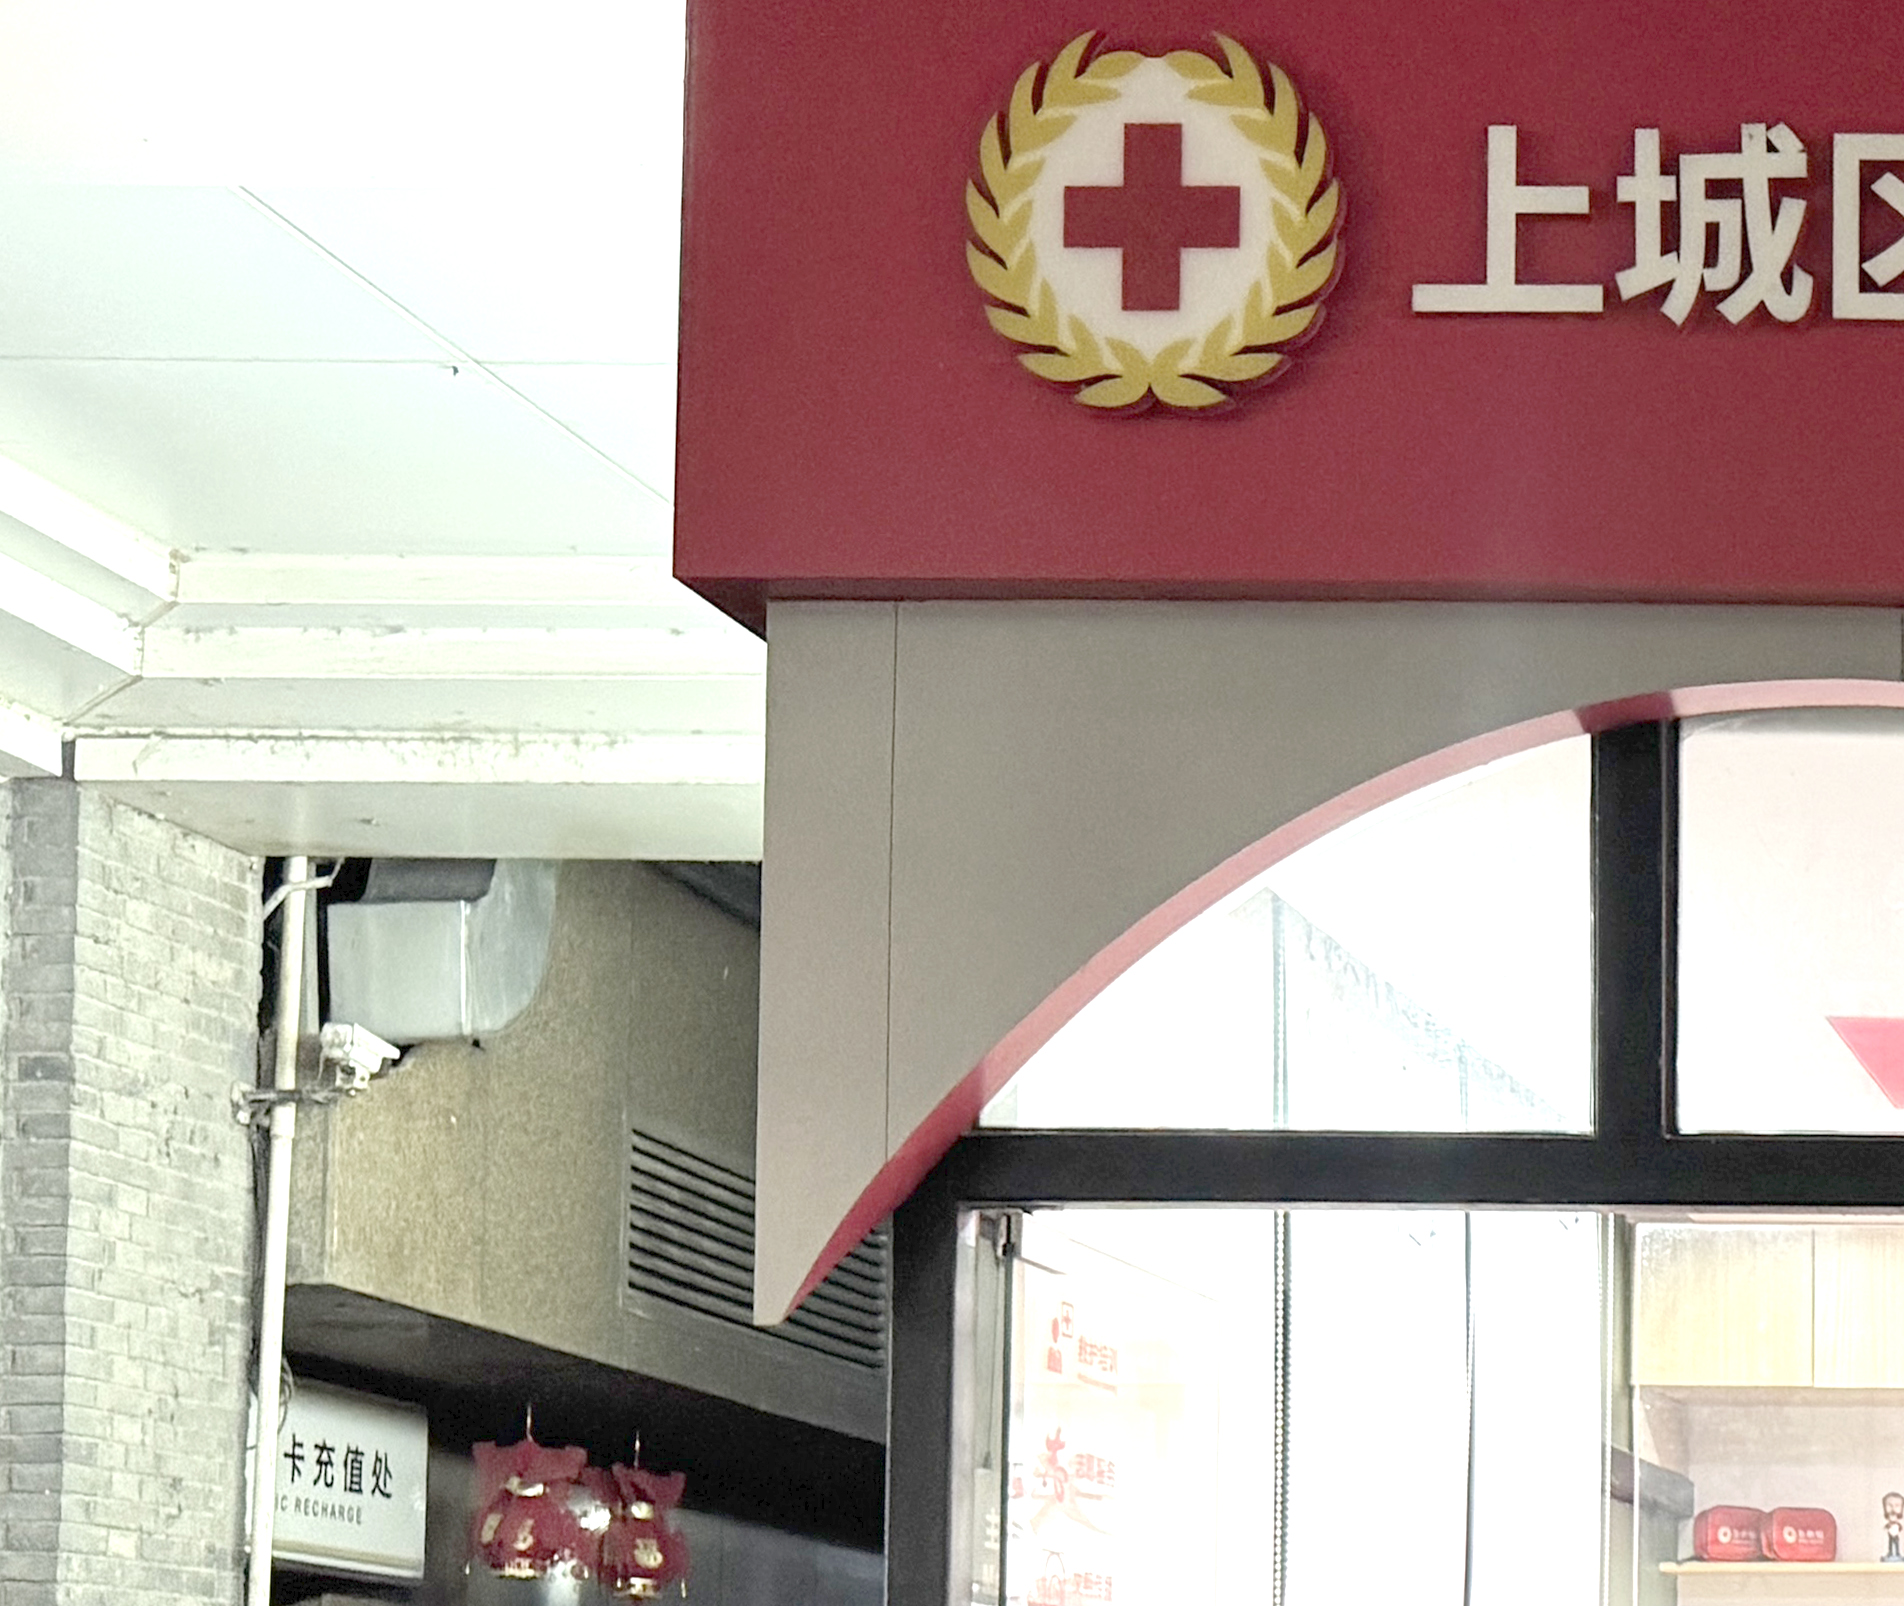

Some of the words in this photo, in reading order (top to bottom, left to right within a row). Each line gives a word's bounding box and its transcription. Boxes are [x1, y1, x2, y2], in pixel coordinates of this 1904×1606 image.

[283, 1432, 394, 1500] 卡充值处
[294, 1497, 363, 1526] RECHARGE
